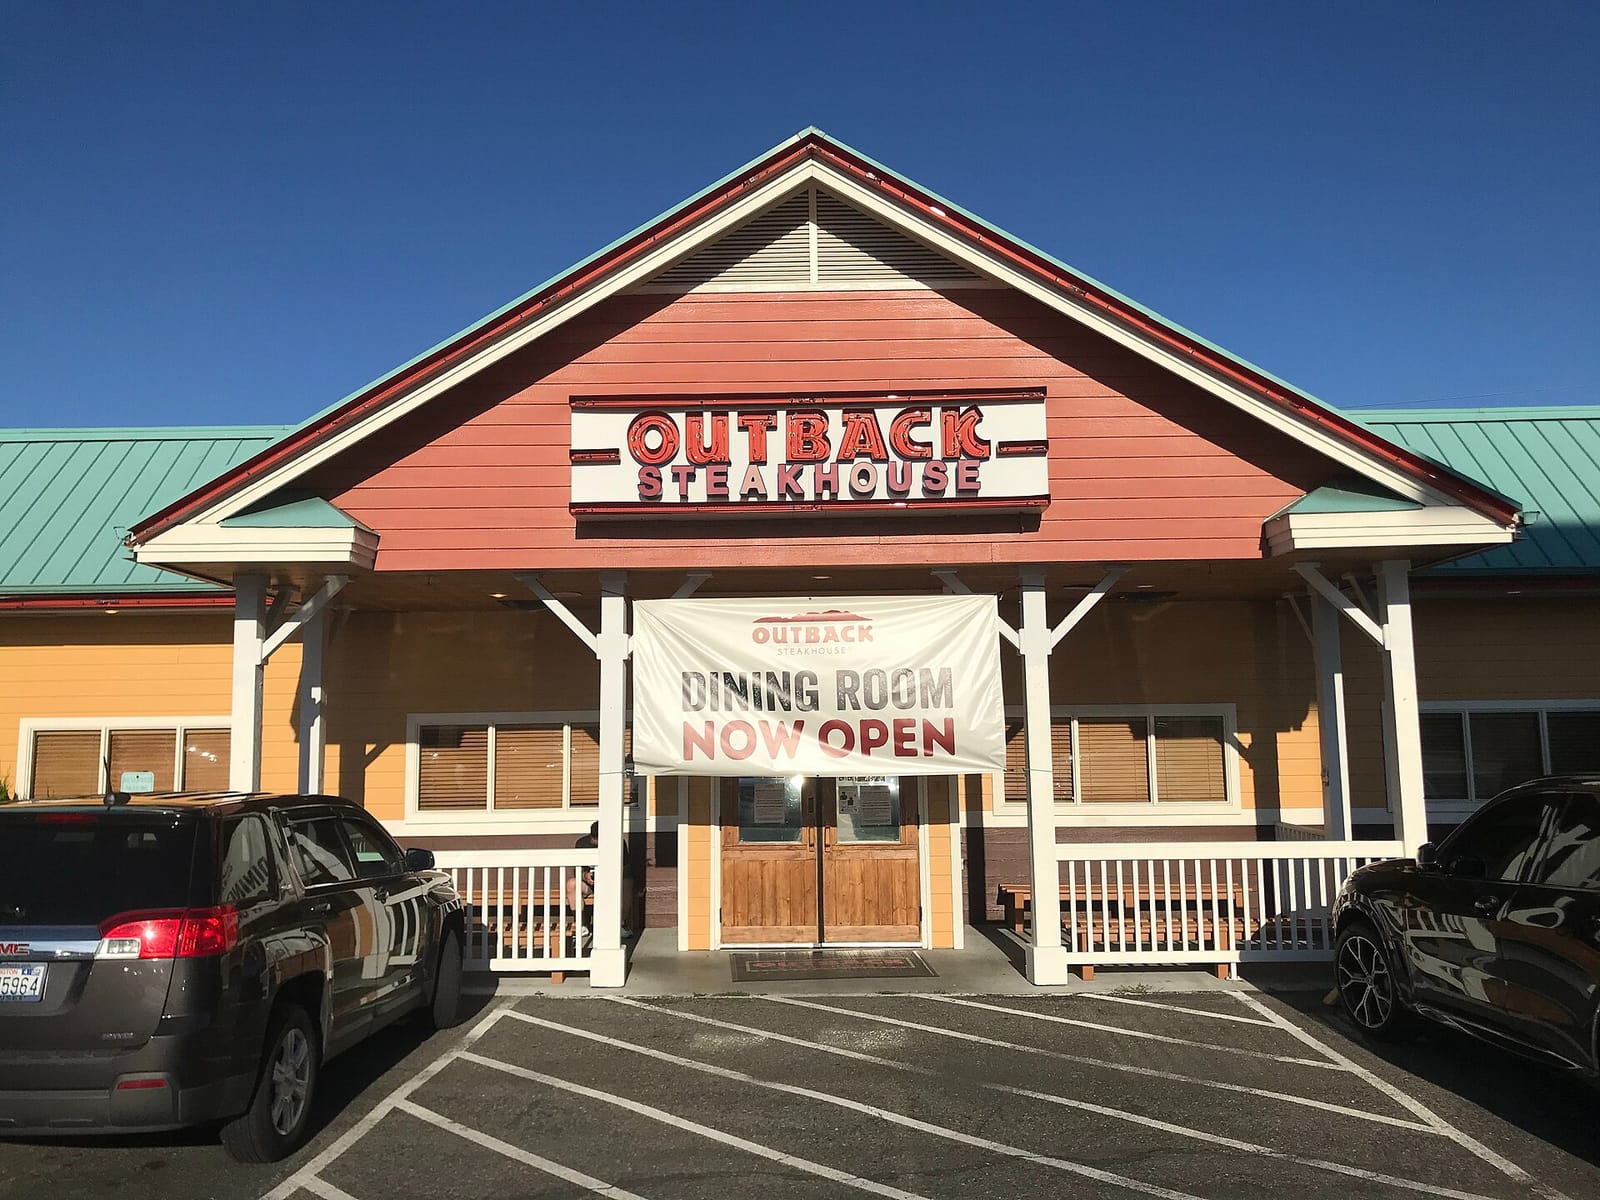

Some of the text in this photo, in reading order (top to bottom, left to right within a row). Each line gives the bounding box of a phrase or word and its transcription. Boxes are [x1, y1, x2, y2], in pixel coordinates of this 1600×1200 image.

[627, 404, 991, 465] OUTBACK
[637, 459, 982, 500] STEAKHOUSE
[752, 625, 874, 644] OUTBACK
[777, 646, 846, 656] STEAKHOUSE
[682, 667, 953, 711] DINING ROOM
[683, 717, 956, 761] NOW OPEN
